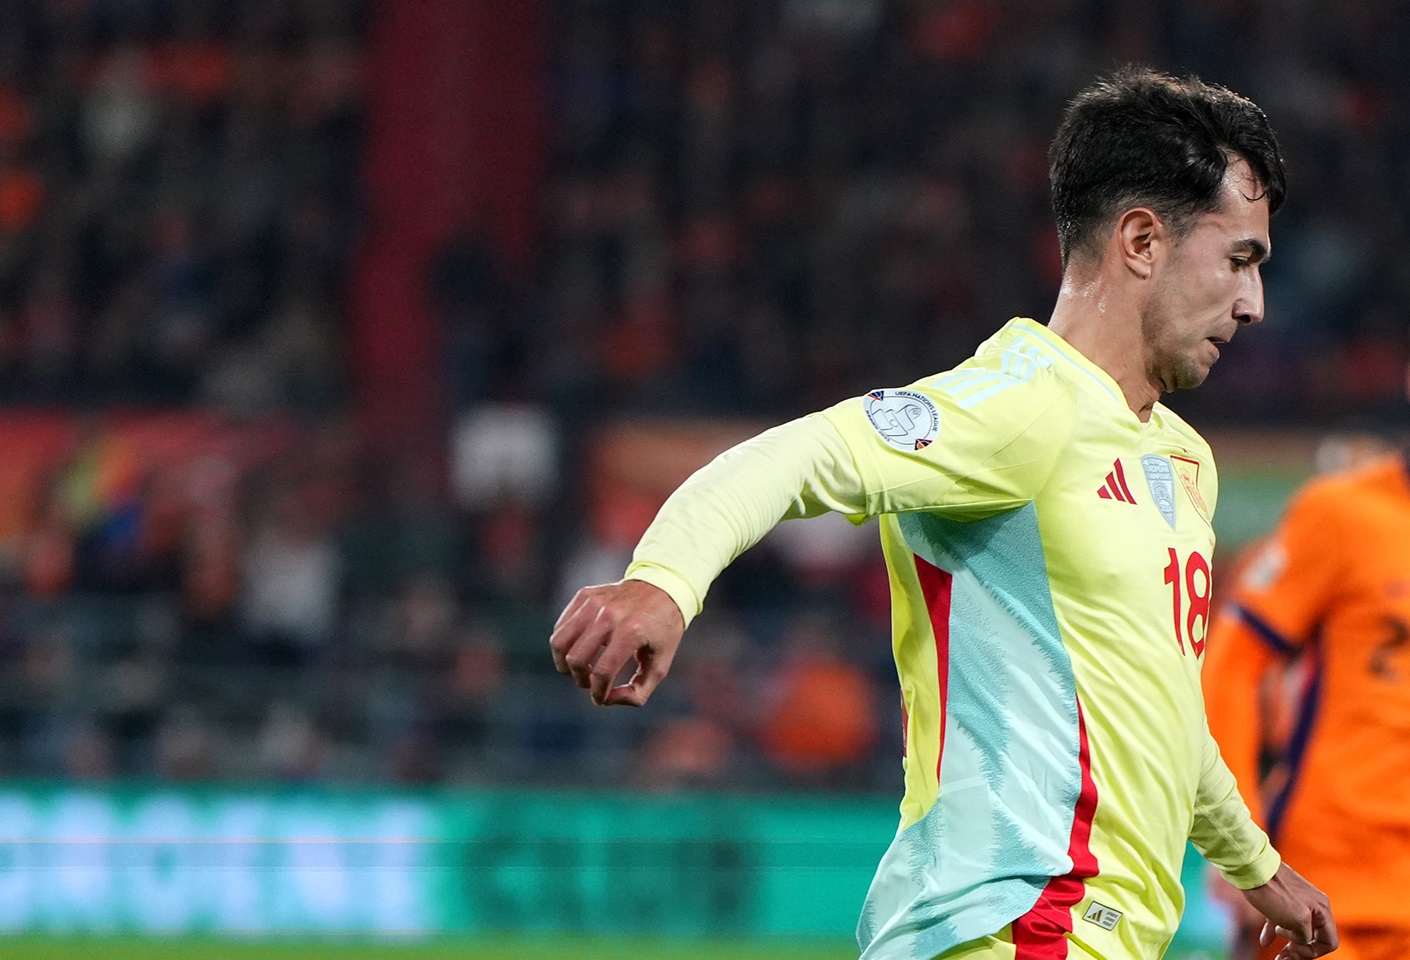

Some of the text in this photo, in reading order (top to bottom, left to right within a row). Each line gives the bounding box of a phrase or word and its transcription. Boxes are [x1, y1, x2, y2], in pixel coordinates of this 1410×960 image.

[911, 393, 935, 413] NATIONS
[931, 409, 940, 432] LEAGUE
[1163, 547, 1211, 659] 18
